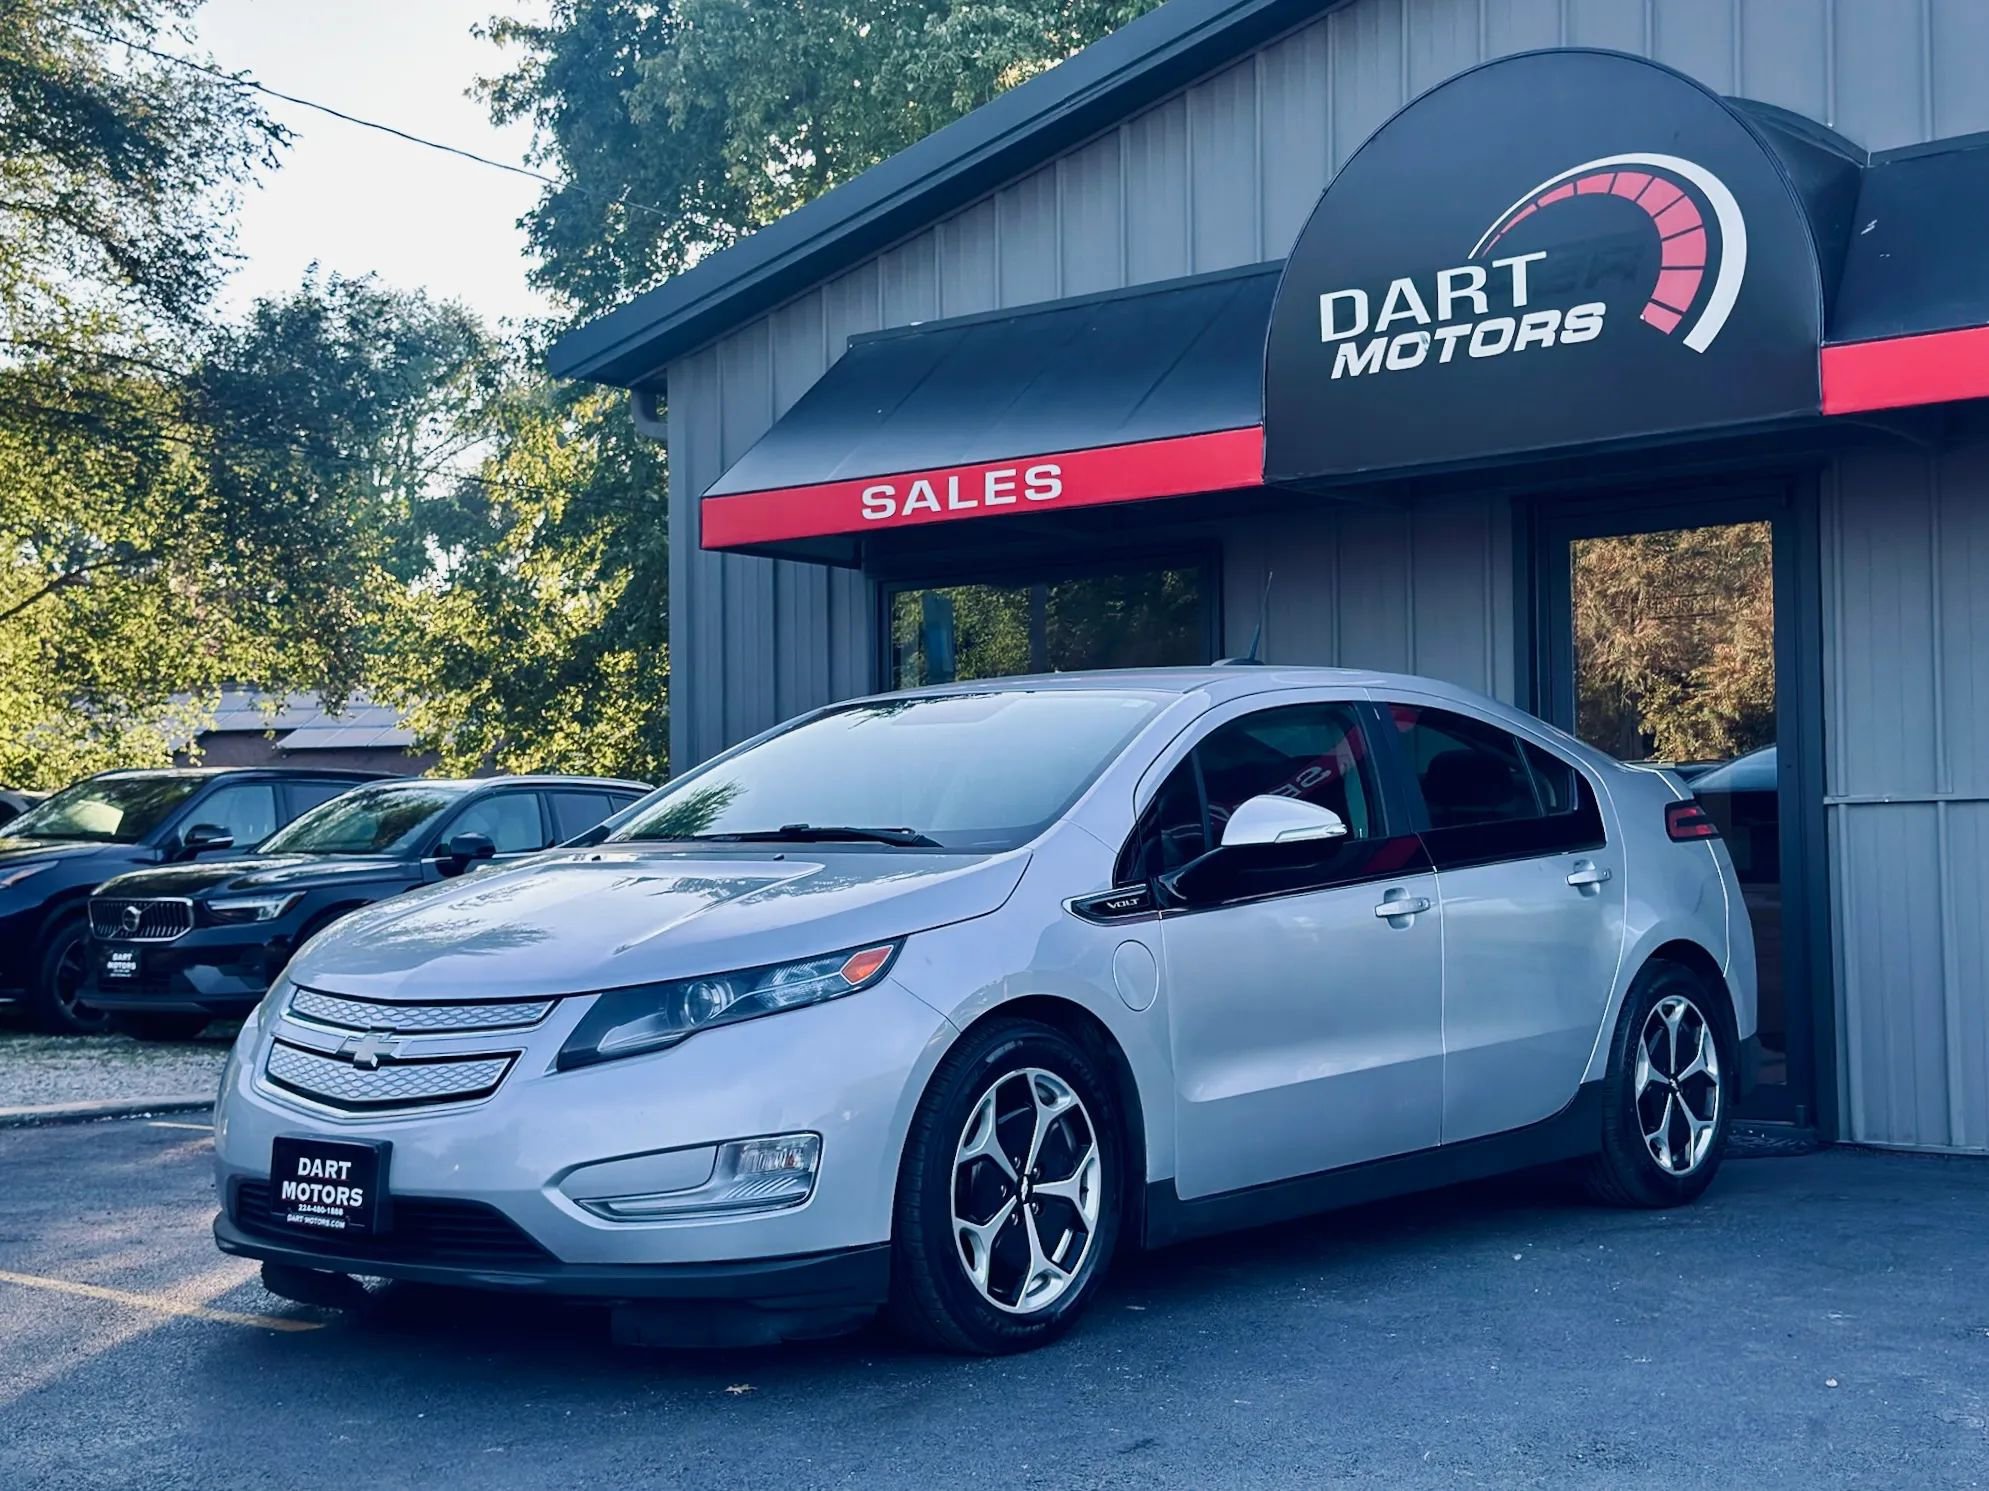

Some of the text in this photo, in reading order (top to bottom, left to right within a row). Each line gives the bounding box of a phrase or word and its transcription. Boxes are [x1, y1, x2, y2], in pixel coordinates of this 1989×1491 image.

[1320, 251, 1548, 343] DART
[1331, 302, 1607, 379] MOTORS
[861, 464, 1062, 520] SALES
[1106, 897, 1140, 909] VOLT
[107, 961, 136, 970] MOTORS
[112, 953, 132, 961] DART
[297, 1157, 352, 1179] DART
[281, 1180, 363, 1207] MOTORS
